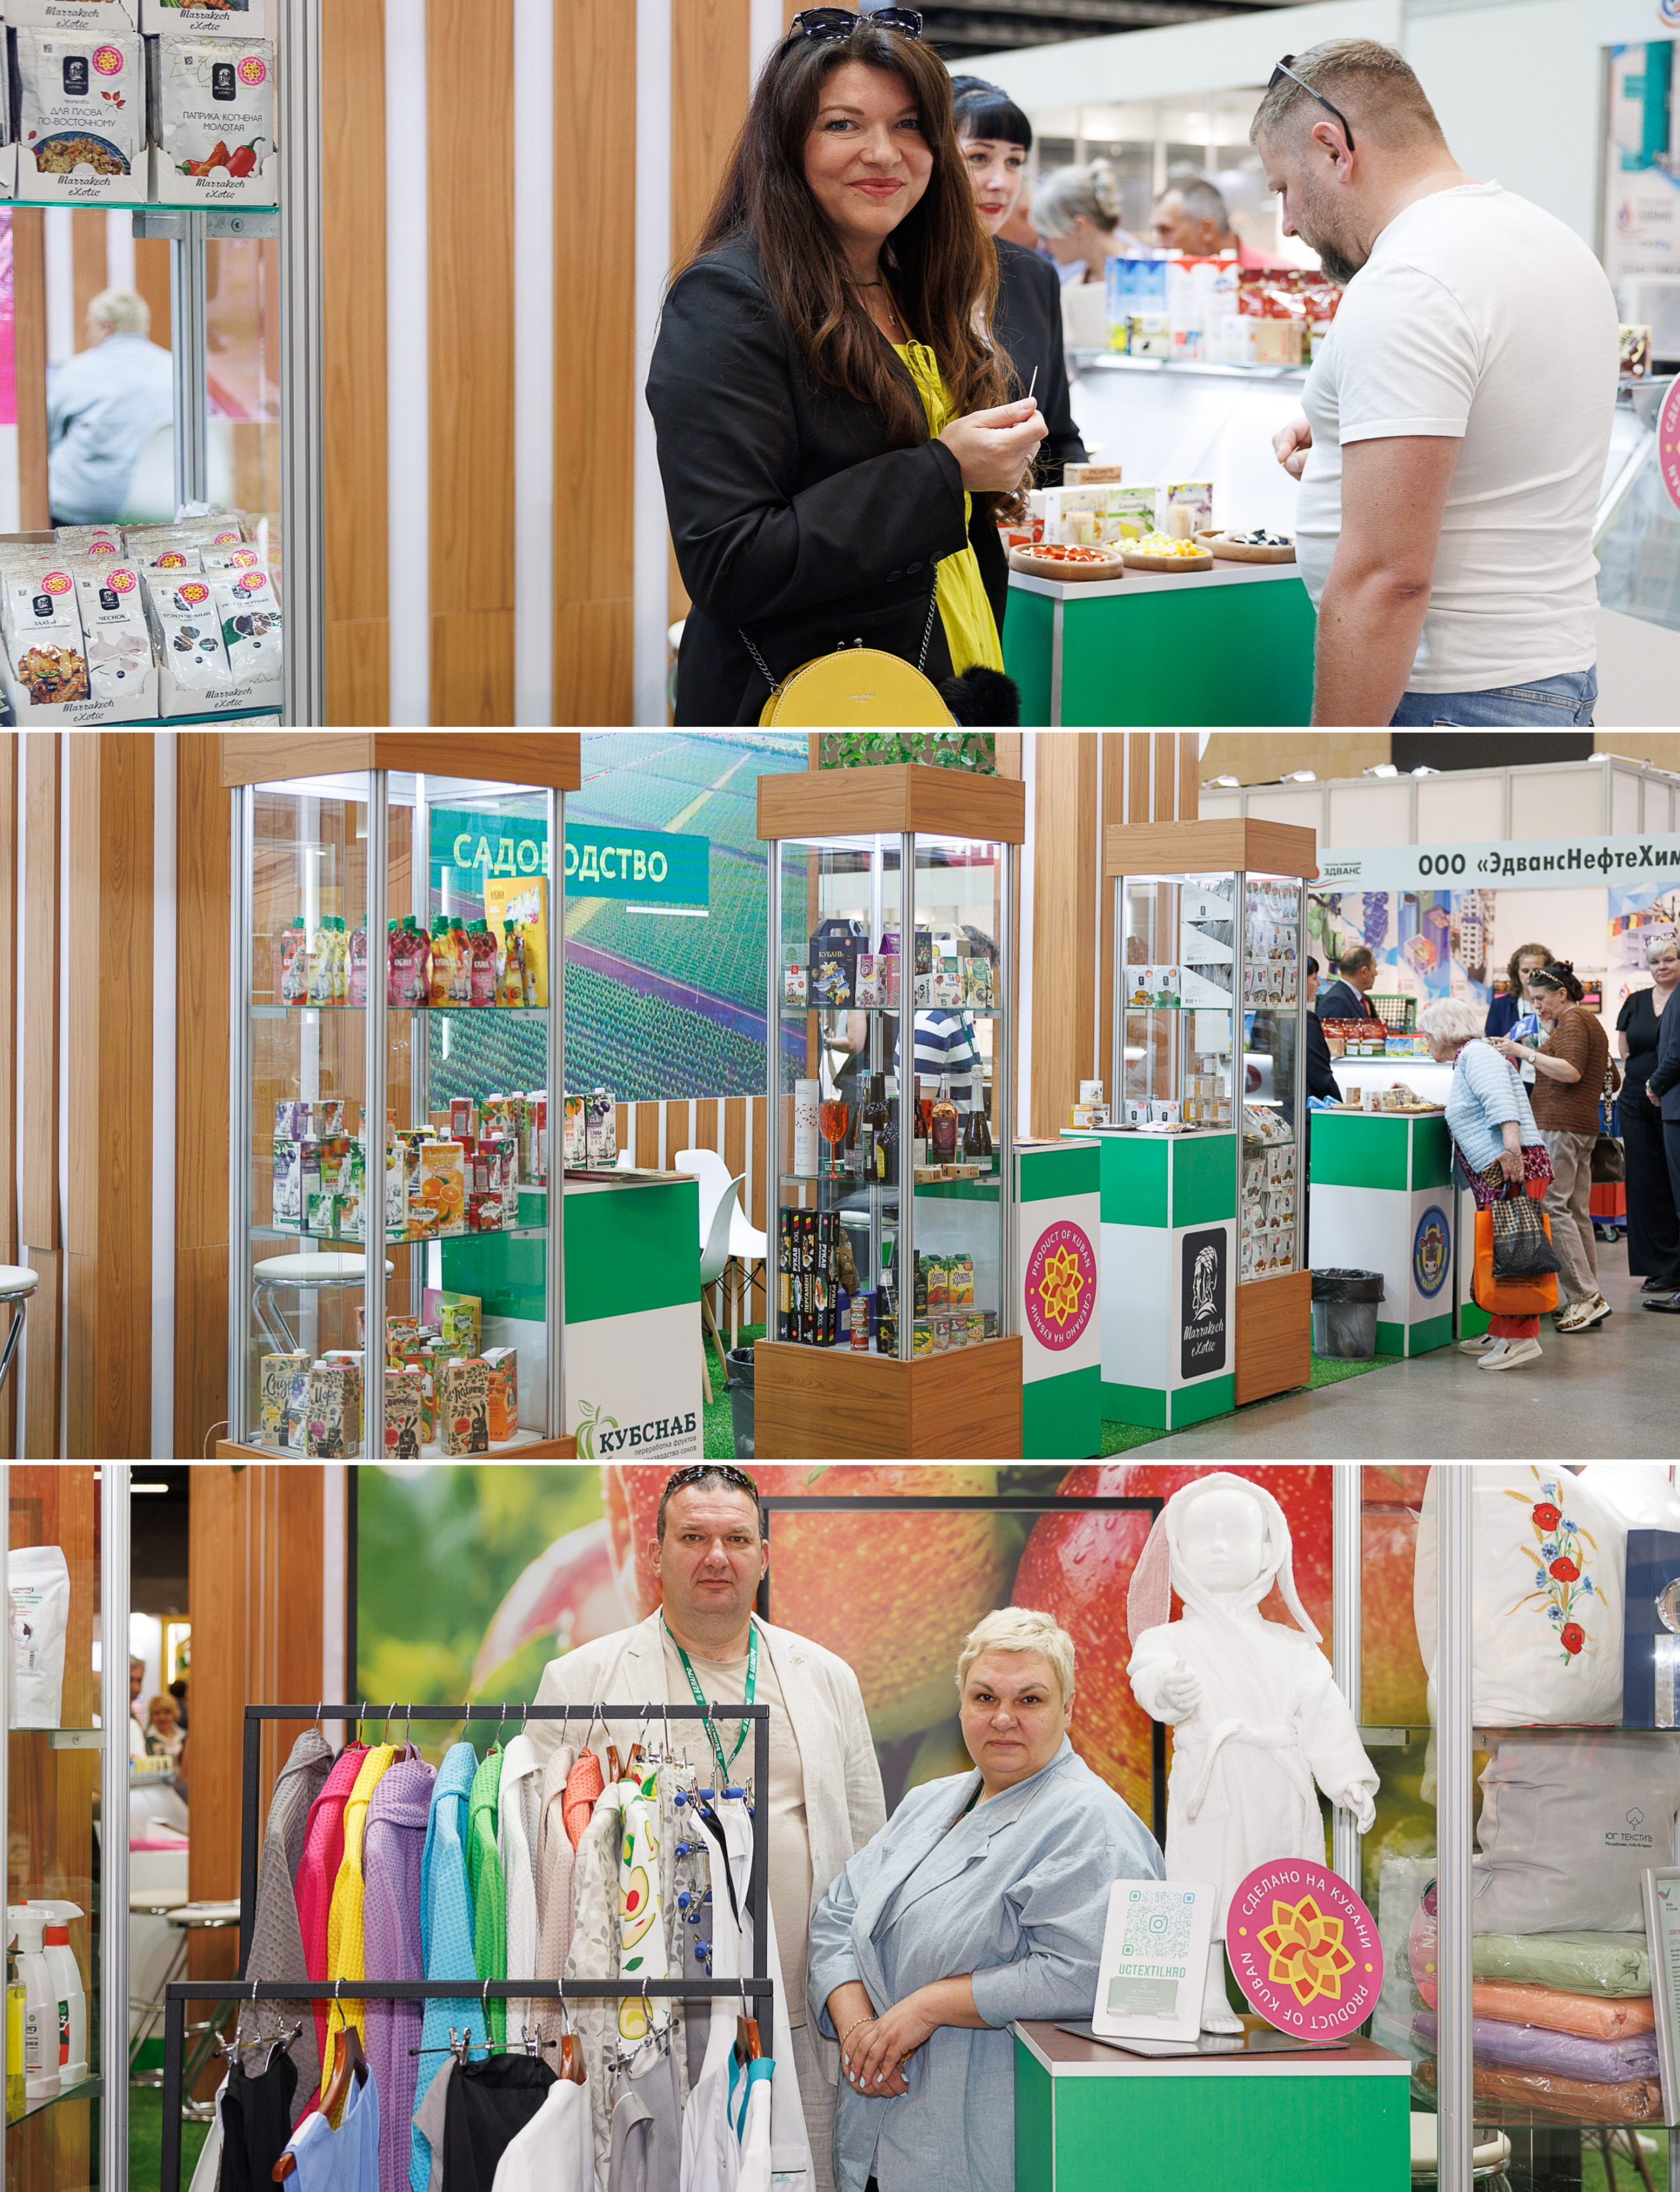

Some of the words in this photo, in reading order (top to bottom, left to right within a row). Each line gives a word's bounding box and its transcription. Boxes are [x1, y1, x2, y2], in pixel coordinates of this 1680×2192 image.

[45, 7, 99, 18] Marrakech
[180, 9, 230, 20] Marrakech
[56, 19, 89, 29] eXotic
[190, 22, 220, 31] eXotic
[72, 108, 103, 116] ПЛОВА
[183, 112, 220, 121] ПАПРИКА
[222, 114, 262, 122] КОПЧЕНАЯ
[37, 117, 117, 127] ПО-ВОСТОЧНОМУ
[203, 123, 245, 132] МОЛОТАЯ
[58, 175, 110, 186] Marrakech
[196, 179, 245, 188] Marrakech
[68, 188, 100, 196] eXotic
[205, 190, 235, 198] eXotic
[205, 688, 252, 700] Marrakech
[63, 700, 115, 713] Marrakech
[215, 698, 243, 709] eXotic
[74, 711, 104, 723] eXotic
[1418, 853, 1466, 876] ООО
[1323, 866, 1361, 876] ЭДВАНС
[1032, 1231, 1059, 1276] PRODUCT
[1060, 1229, 1072, 1240] OF
[1072, 1233, 1091, 1269] KUBAN
[1030, 1303, 1053, 1341] КУБАНИ
[1066, 1292, 1091, 1340] СДЕЛАНО
[1183, 1318, 1224, 1341] Marrakech
[1054, 1333, 1064, 1343] НА
[1191, 1339, 1215, 1357] eXotic
[310, 1385, 338, 1406] Морс
[599, 1412, 697, 1454] КУБСНАБ
[634, 1441, 672, 1456] переработка
[673, 1435, 697, 1448] фруктов
[681, 1445, 697, 1455] соков
[686, 1667, 702, 1695] БЕЛАГРО
[1620, 1833, 1653, 1842] ТЕКСТИЛЬ
[1242, 1870, 1301, 1916] СДЕЛАНО
[1305, 1872, 1326, 1891] НА
[1330, 1886, 1372, 1949] КУБАНИ
[1119, 1963, 1186, 1979] UGTEXTILKRD
[1240, 1952, 1280, 2012] KUBAN
[1310, 1983, 1369, 2029] PRODUCT
[1282, 2008, 1304, 2027] OF
